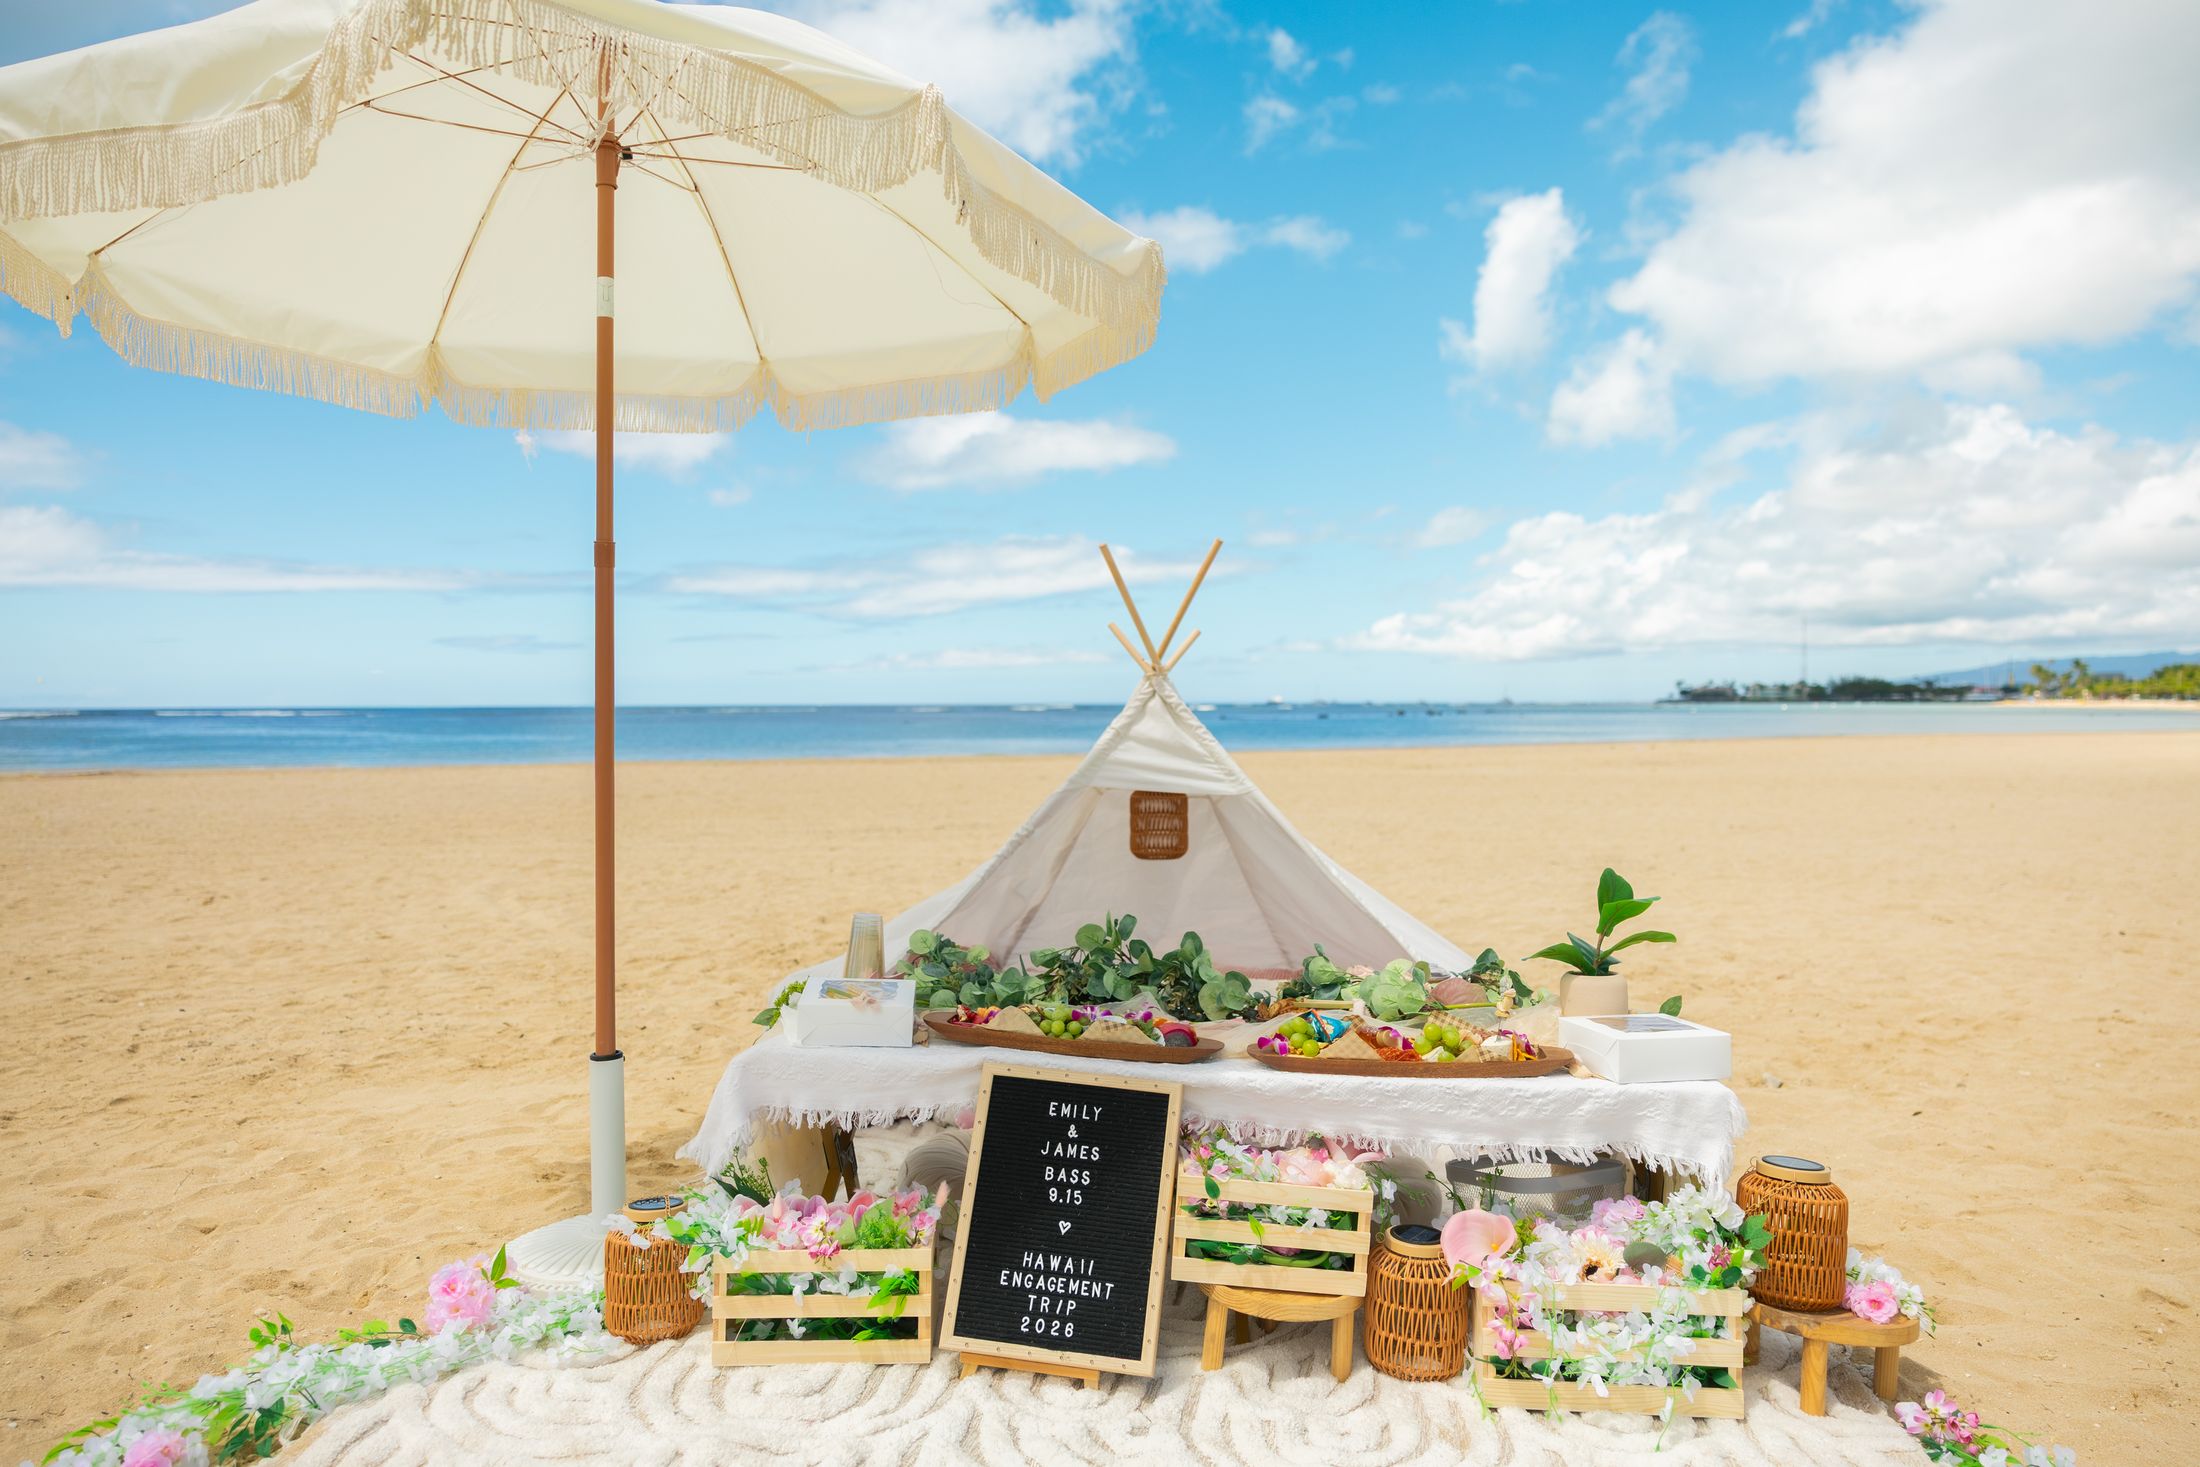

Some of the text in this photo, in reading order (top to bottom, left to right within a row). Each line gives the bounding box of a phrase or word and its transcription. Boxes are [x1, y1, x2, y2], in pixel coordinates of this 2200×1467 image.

[1048, 1101, 1103, 1122] EMILY
[1067, 1123, 1079, 1139] &
[1040, 1140, 1100, 1162] JAMES
[1044, 1166, 1091, 1187] BASS
[1048, 1187, 1083, 1206] 9.15
[1022, 1251, 1095, 1276] HAWAII
[999, 1269, 1115, 1301] ENGAGEMENT
[1028, 1294, 1077, 1316] TRIP
[1020, 1315, 1074, 1338] 2026
